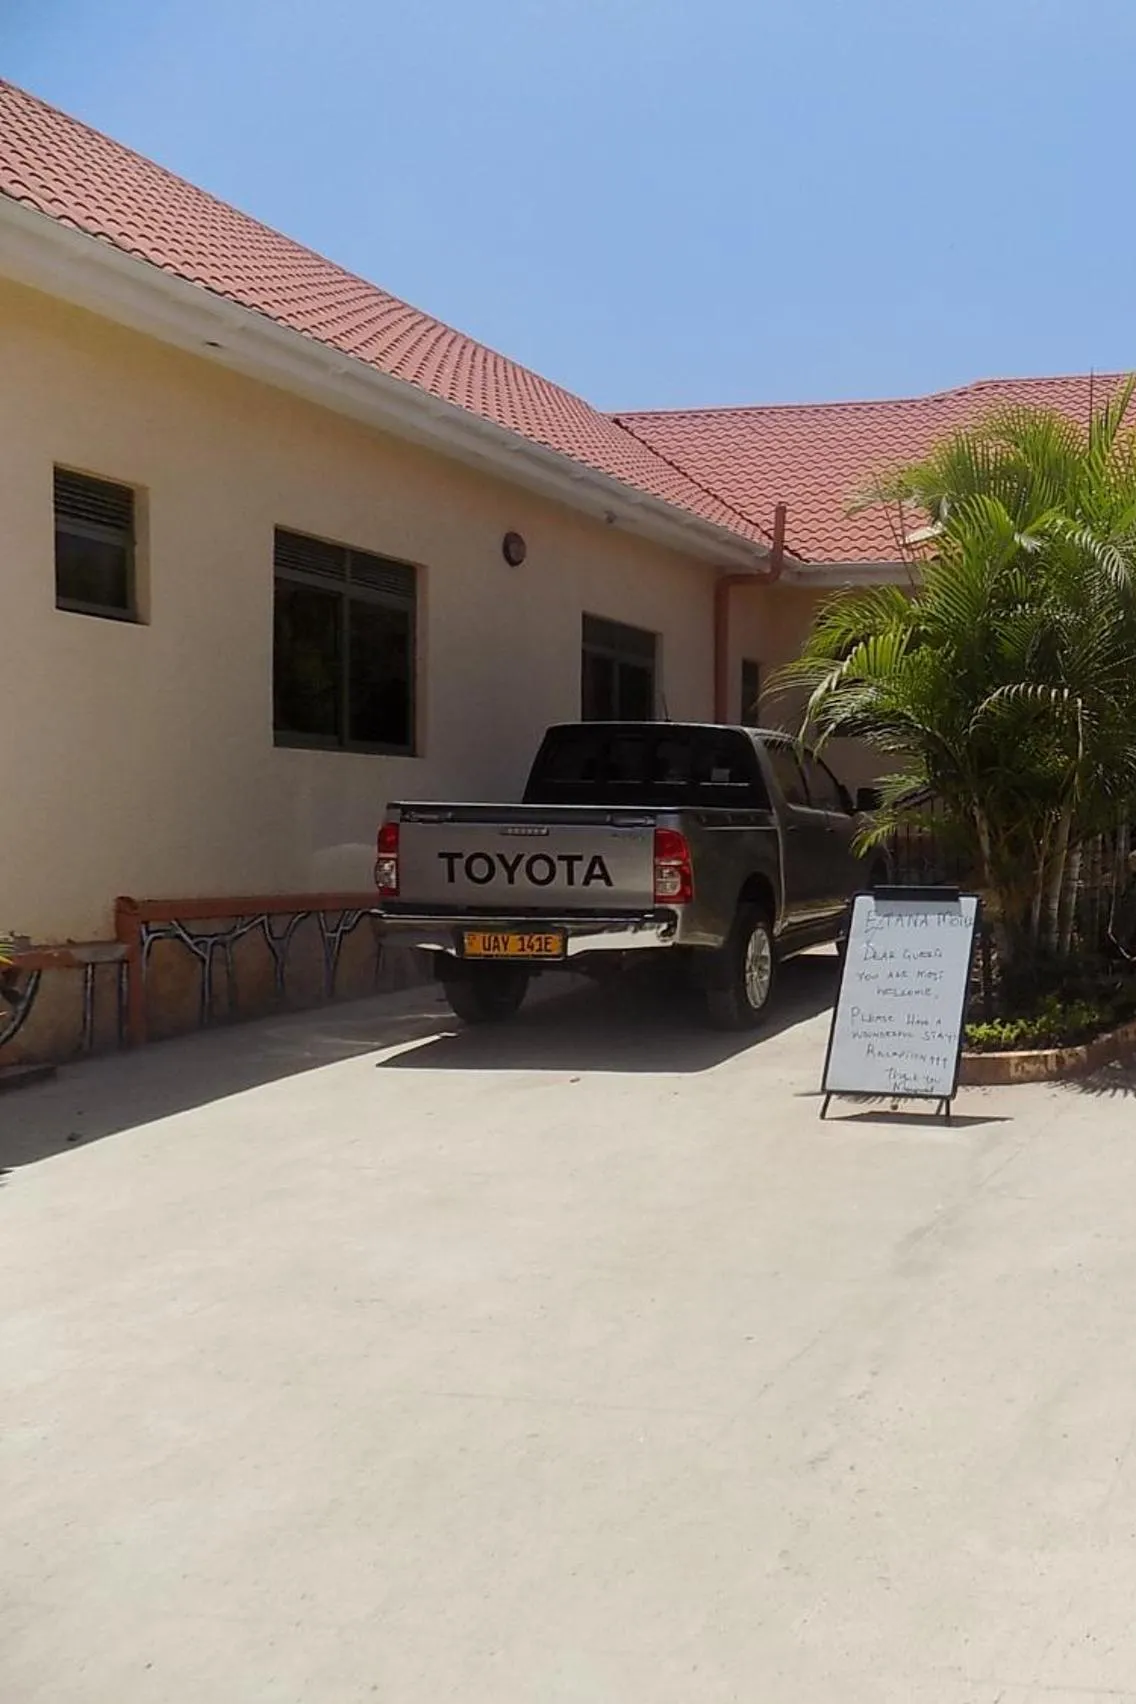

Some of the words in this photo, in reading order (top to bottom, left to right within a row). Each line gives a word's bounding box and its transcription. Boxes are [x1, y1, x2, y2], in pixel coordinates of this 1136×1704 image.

[438, 852, 613, 887] TOYOTA
[482, 935, 510, 952] UAY
[517, 935, 553, 952] 141E
